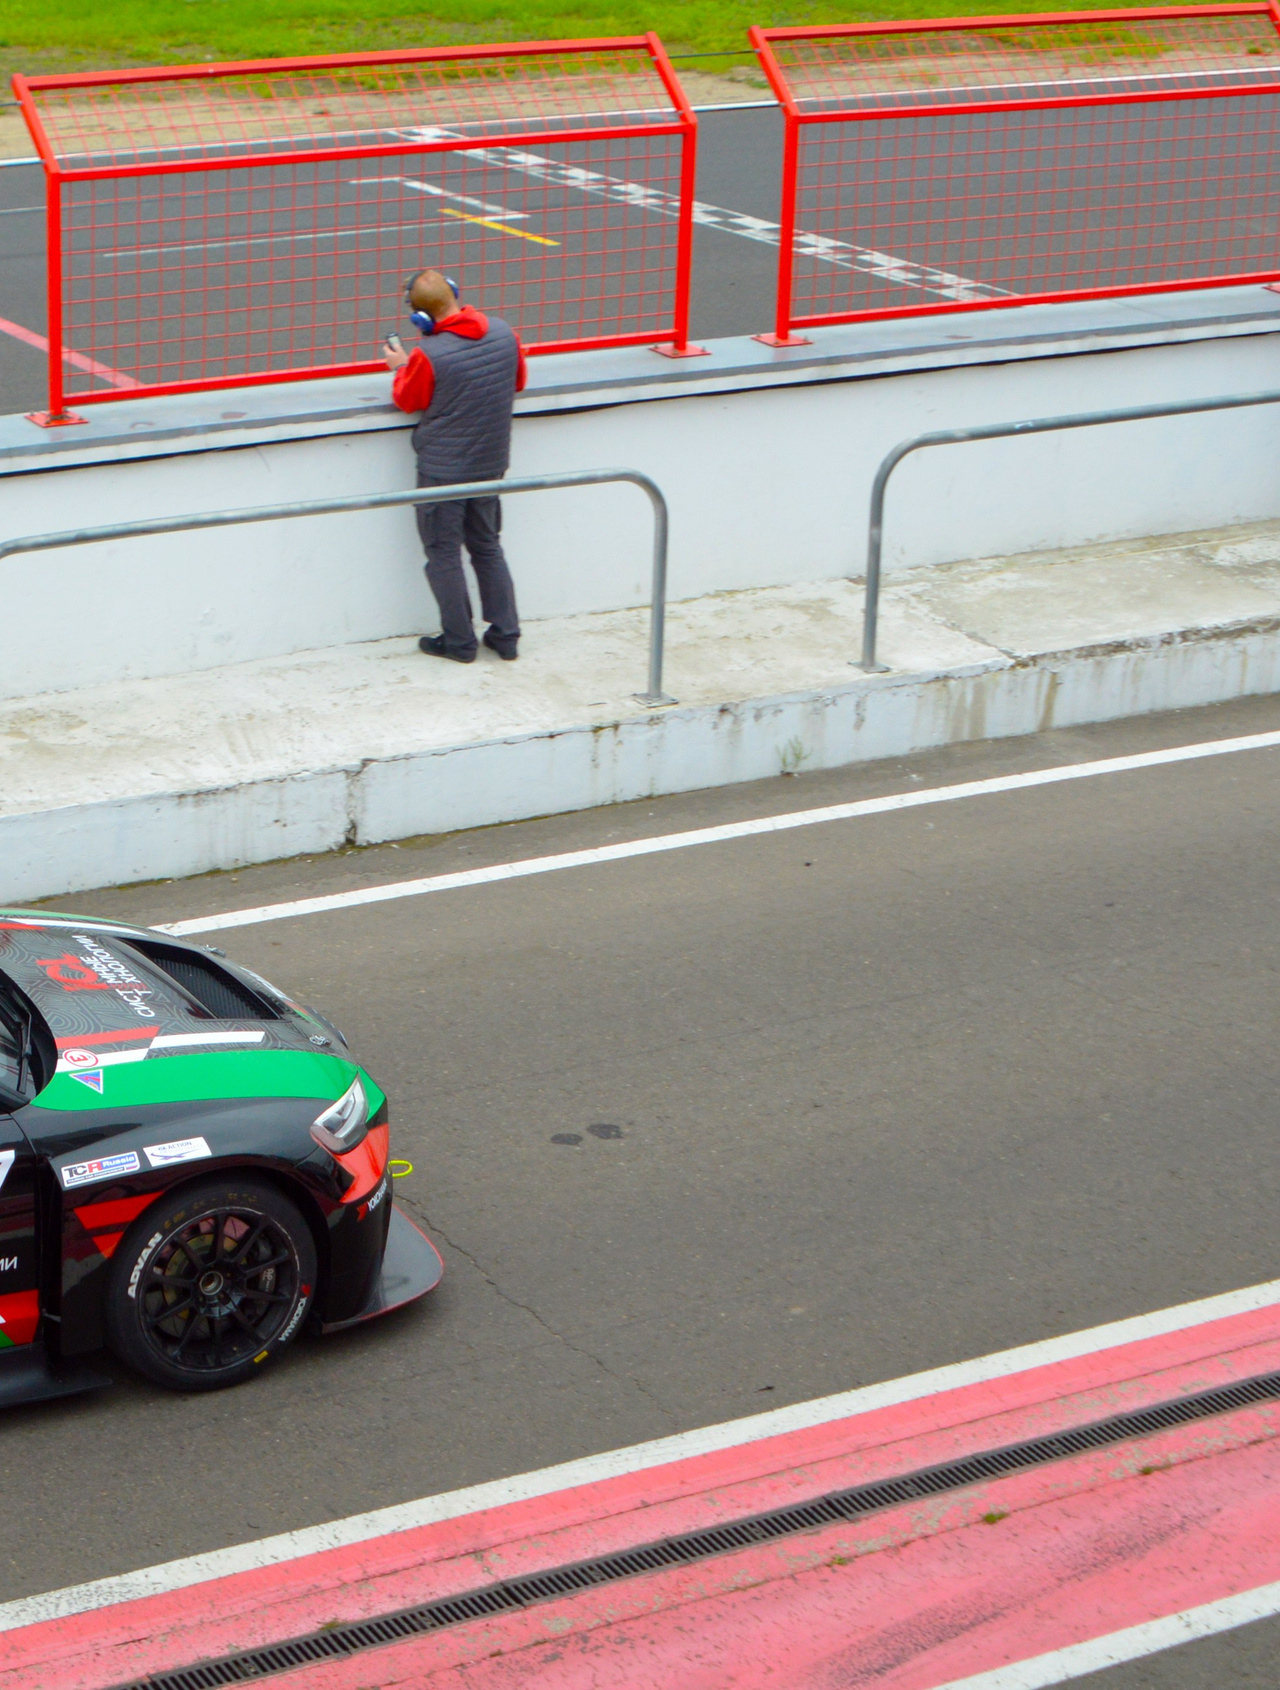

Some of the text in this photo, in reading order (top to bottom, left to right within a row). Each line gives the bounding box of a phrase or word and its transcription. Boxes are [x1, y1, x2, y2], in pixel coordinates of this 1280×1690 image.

[64, 1161, 103, 1178] TCR
[102, 1155, 136, 1168] Russia
[127, 1231, 163, 1299] ADVAN
